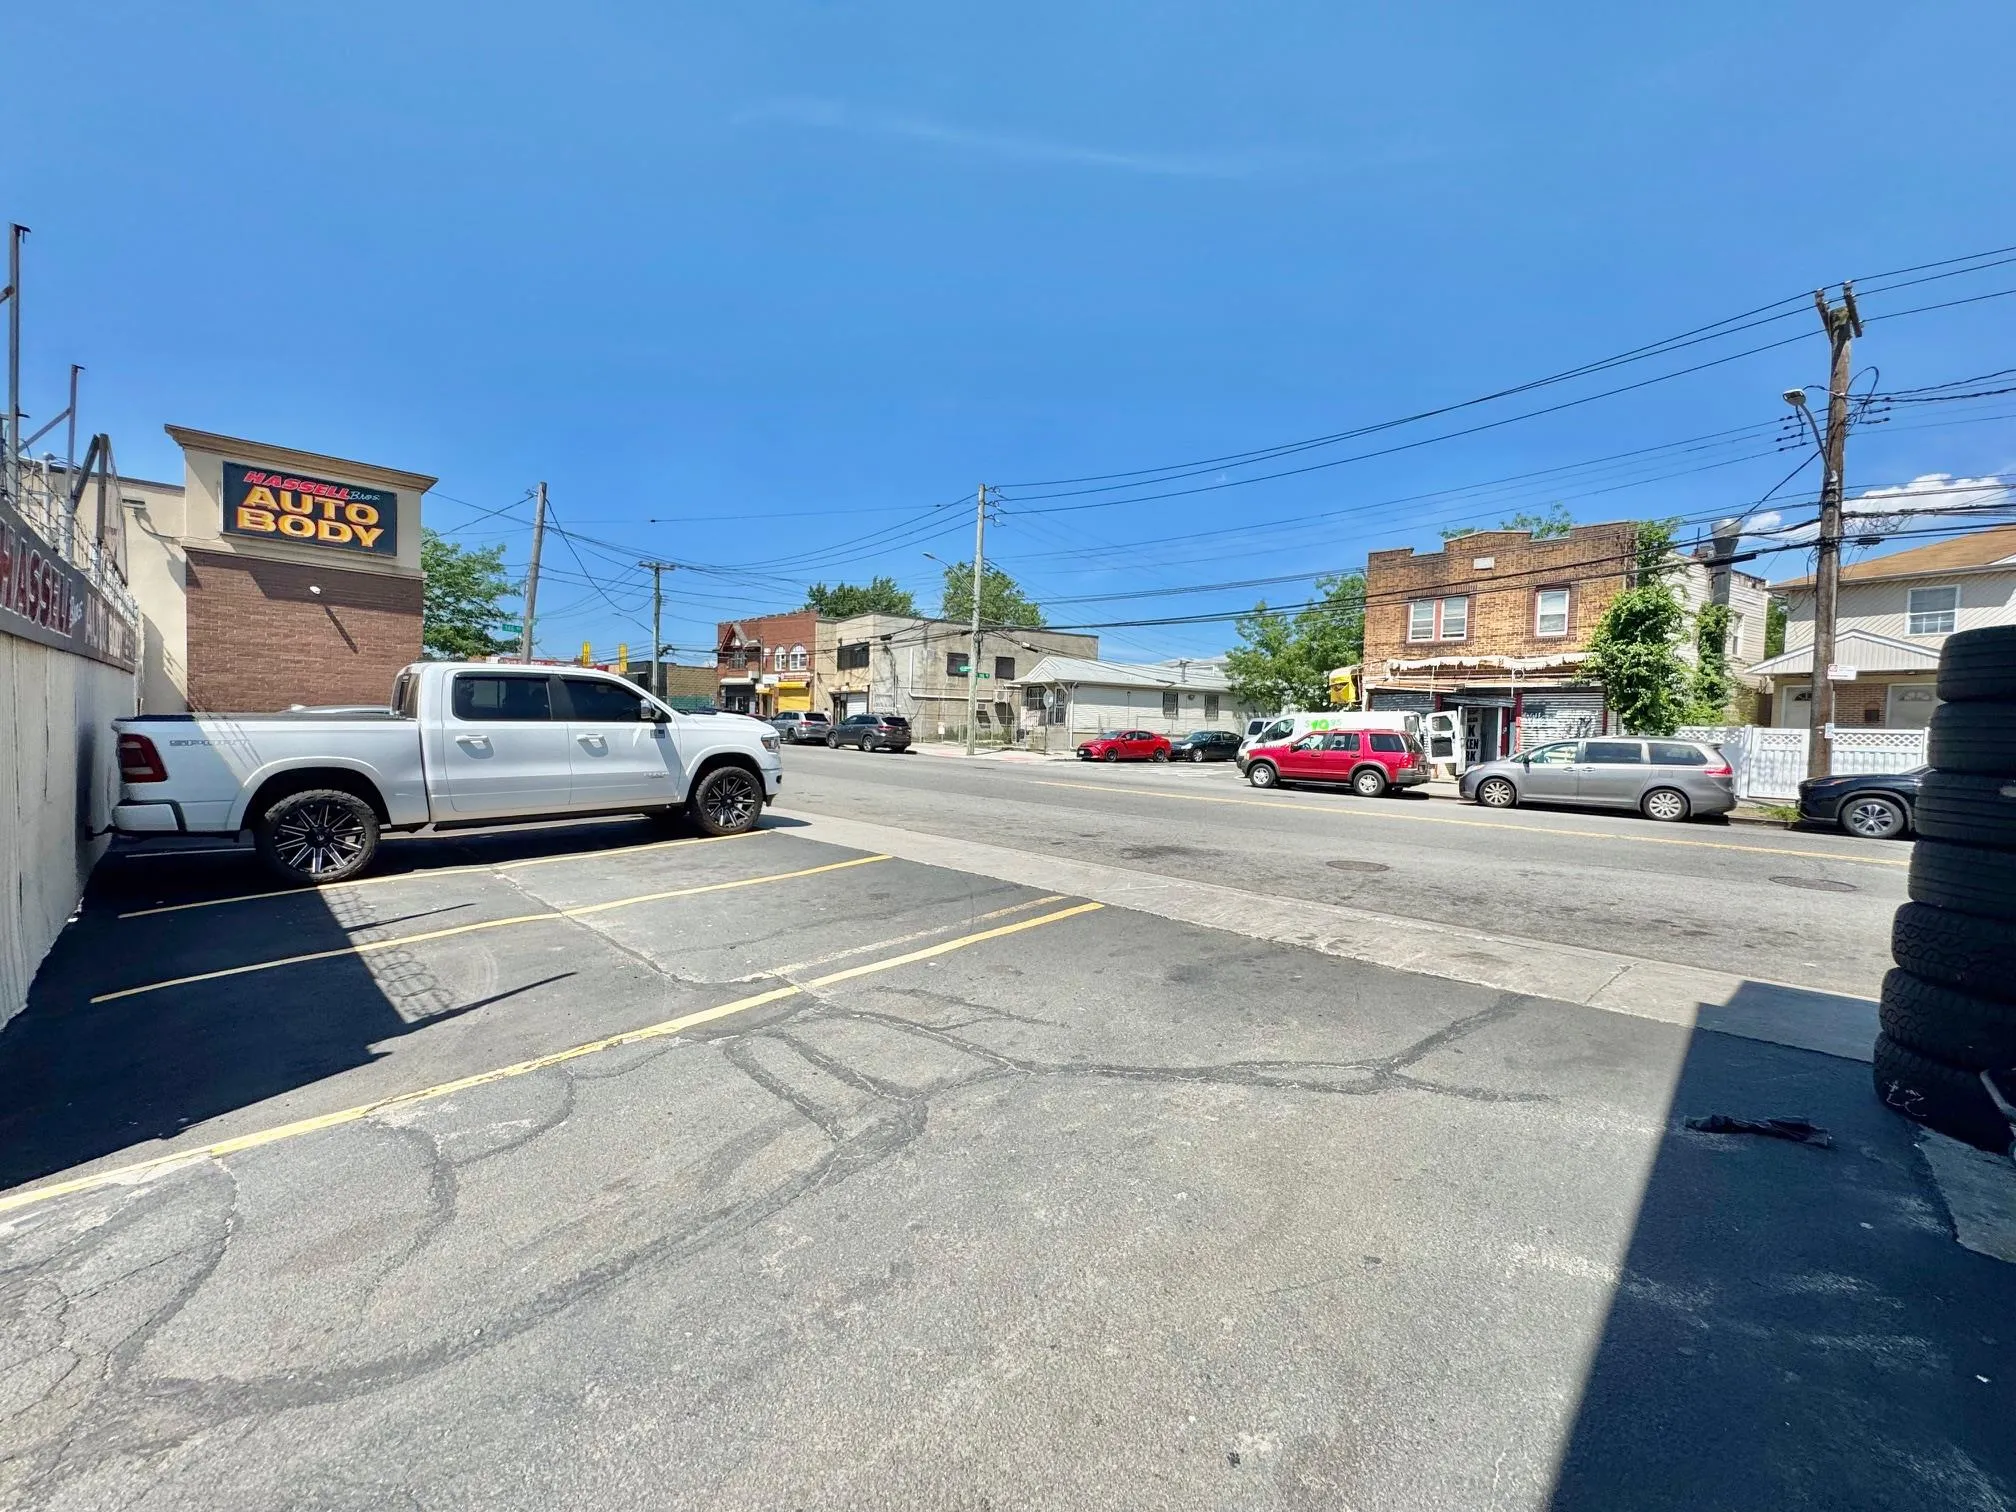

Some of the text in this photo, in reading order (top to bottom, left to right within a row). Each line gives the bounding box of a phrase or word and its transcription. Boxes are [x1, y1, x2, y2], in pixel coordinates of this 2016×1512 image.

[243, 471, 351, 500] HASSELL
[243, 485, 380, 526] AUTO
[237, 506, 385, 548] BODY
